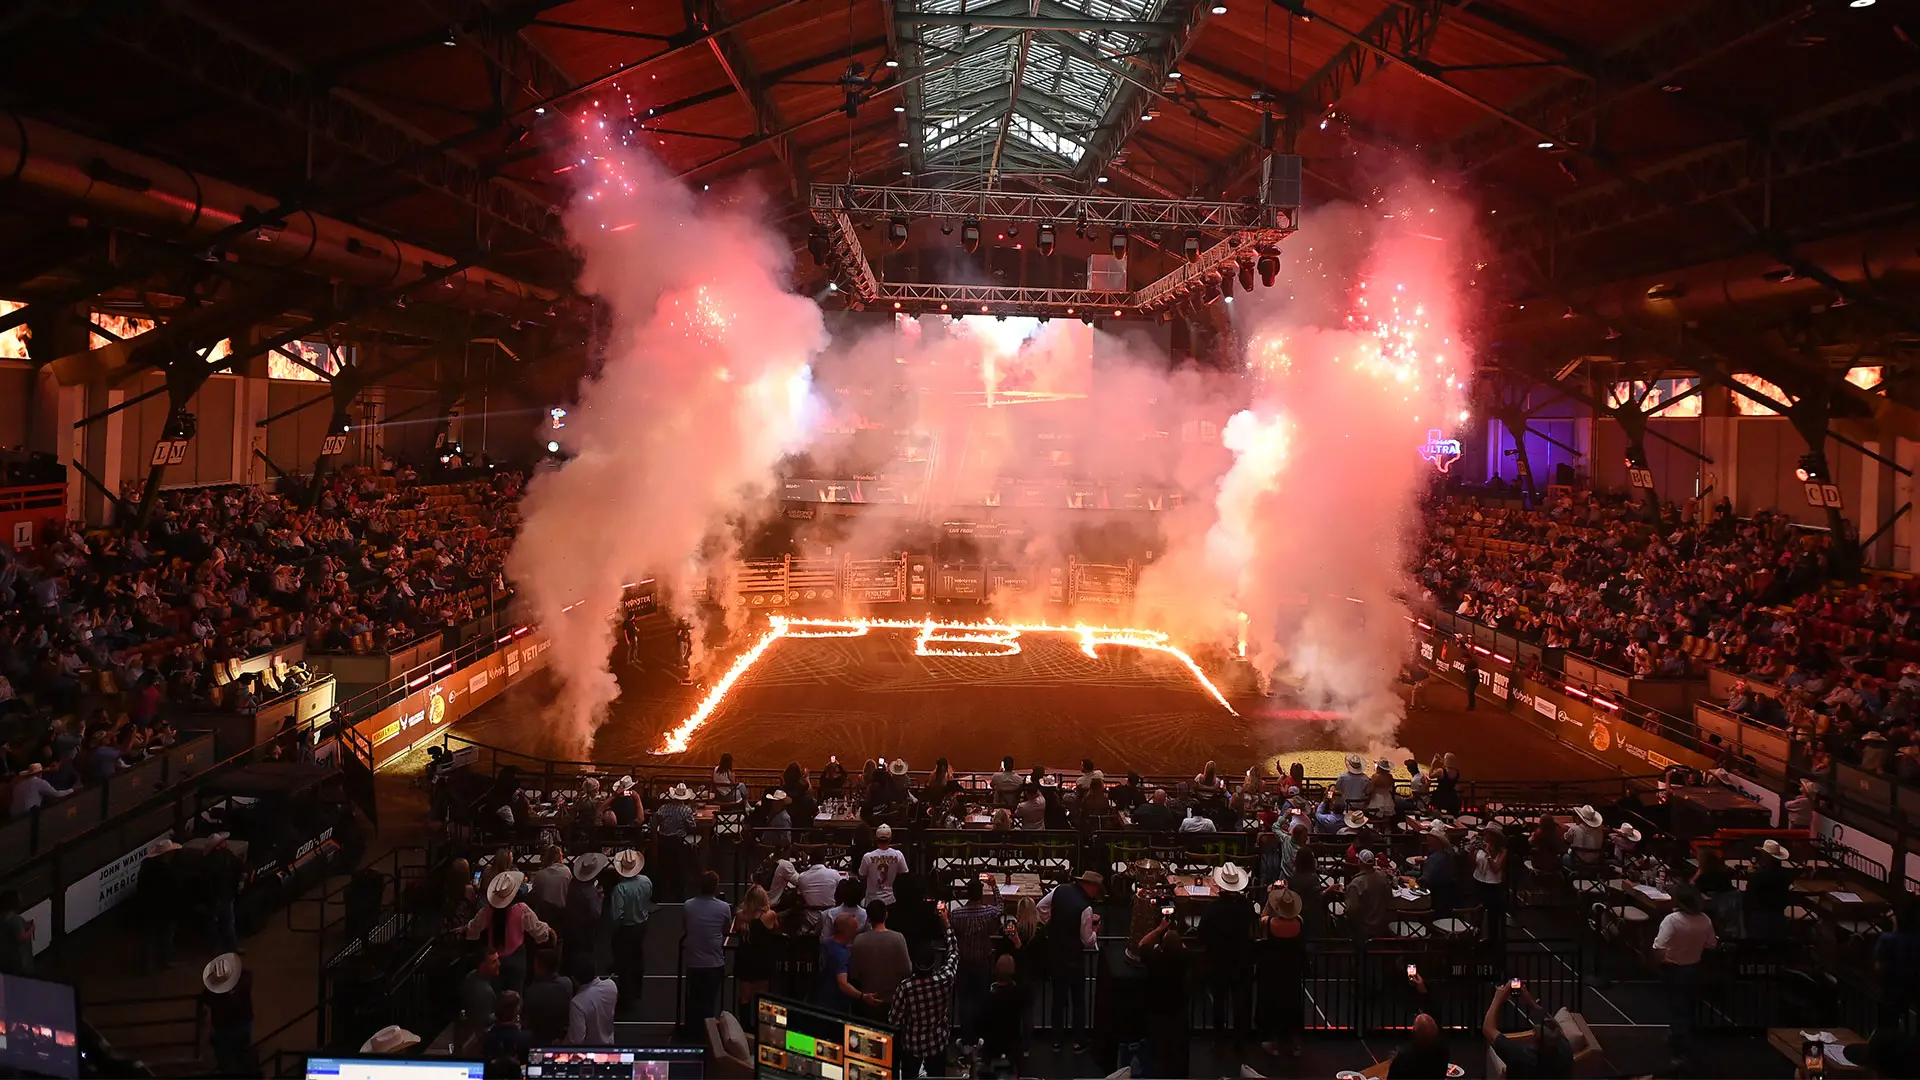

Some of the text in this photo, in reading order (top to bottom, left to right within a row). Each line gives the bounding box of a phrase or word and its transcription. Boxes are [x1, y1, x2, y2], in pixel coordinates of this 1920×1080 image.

[156, 446, 187, 460] L M
[1423, 445, 1456, 454] ULTRA
[1809, 488, 1838, 502] C D
[18, 526, 30, 543] L
[624, 596, 651, 608] MONSTER
[522, 643, 538, 663] YETI
[1478, 669, 1490, 686] ETI
[1512, 687, 1533, 706] Kubota
[99, 847, 148, 881] JOHN WAYNE
[99, 873, 136, 902] AMERIC
